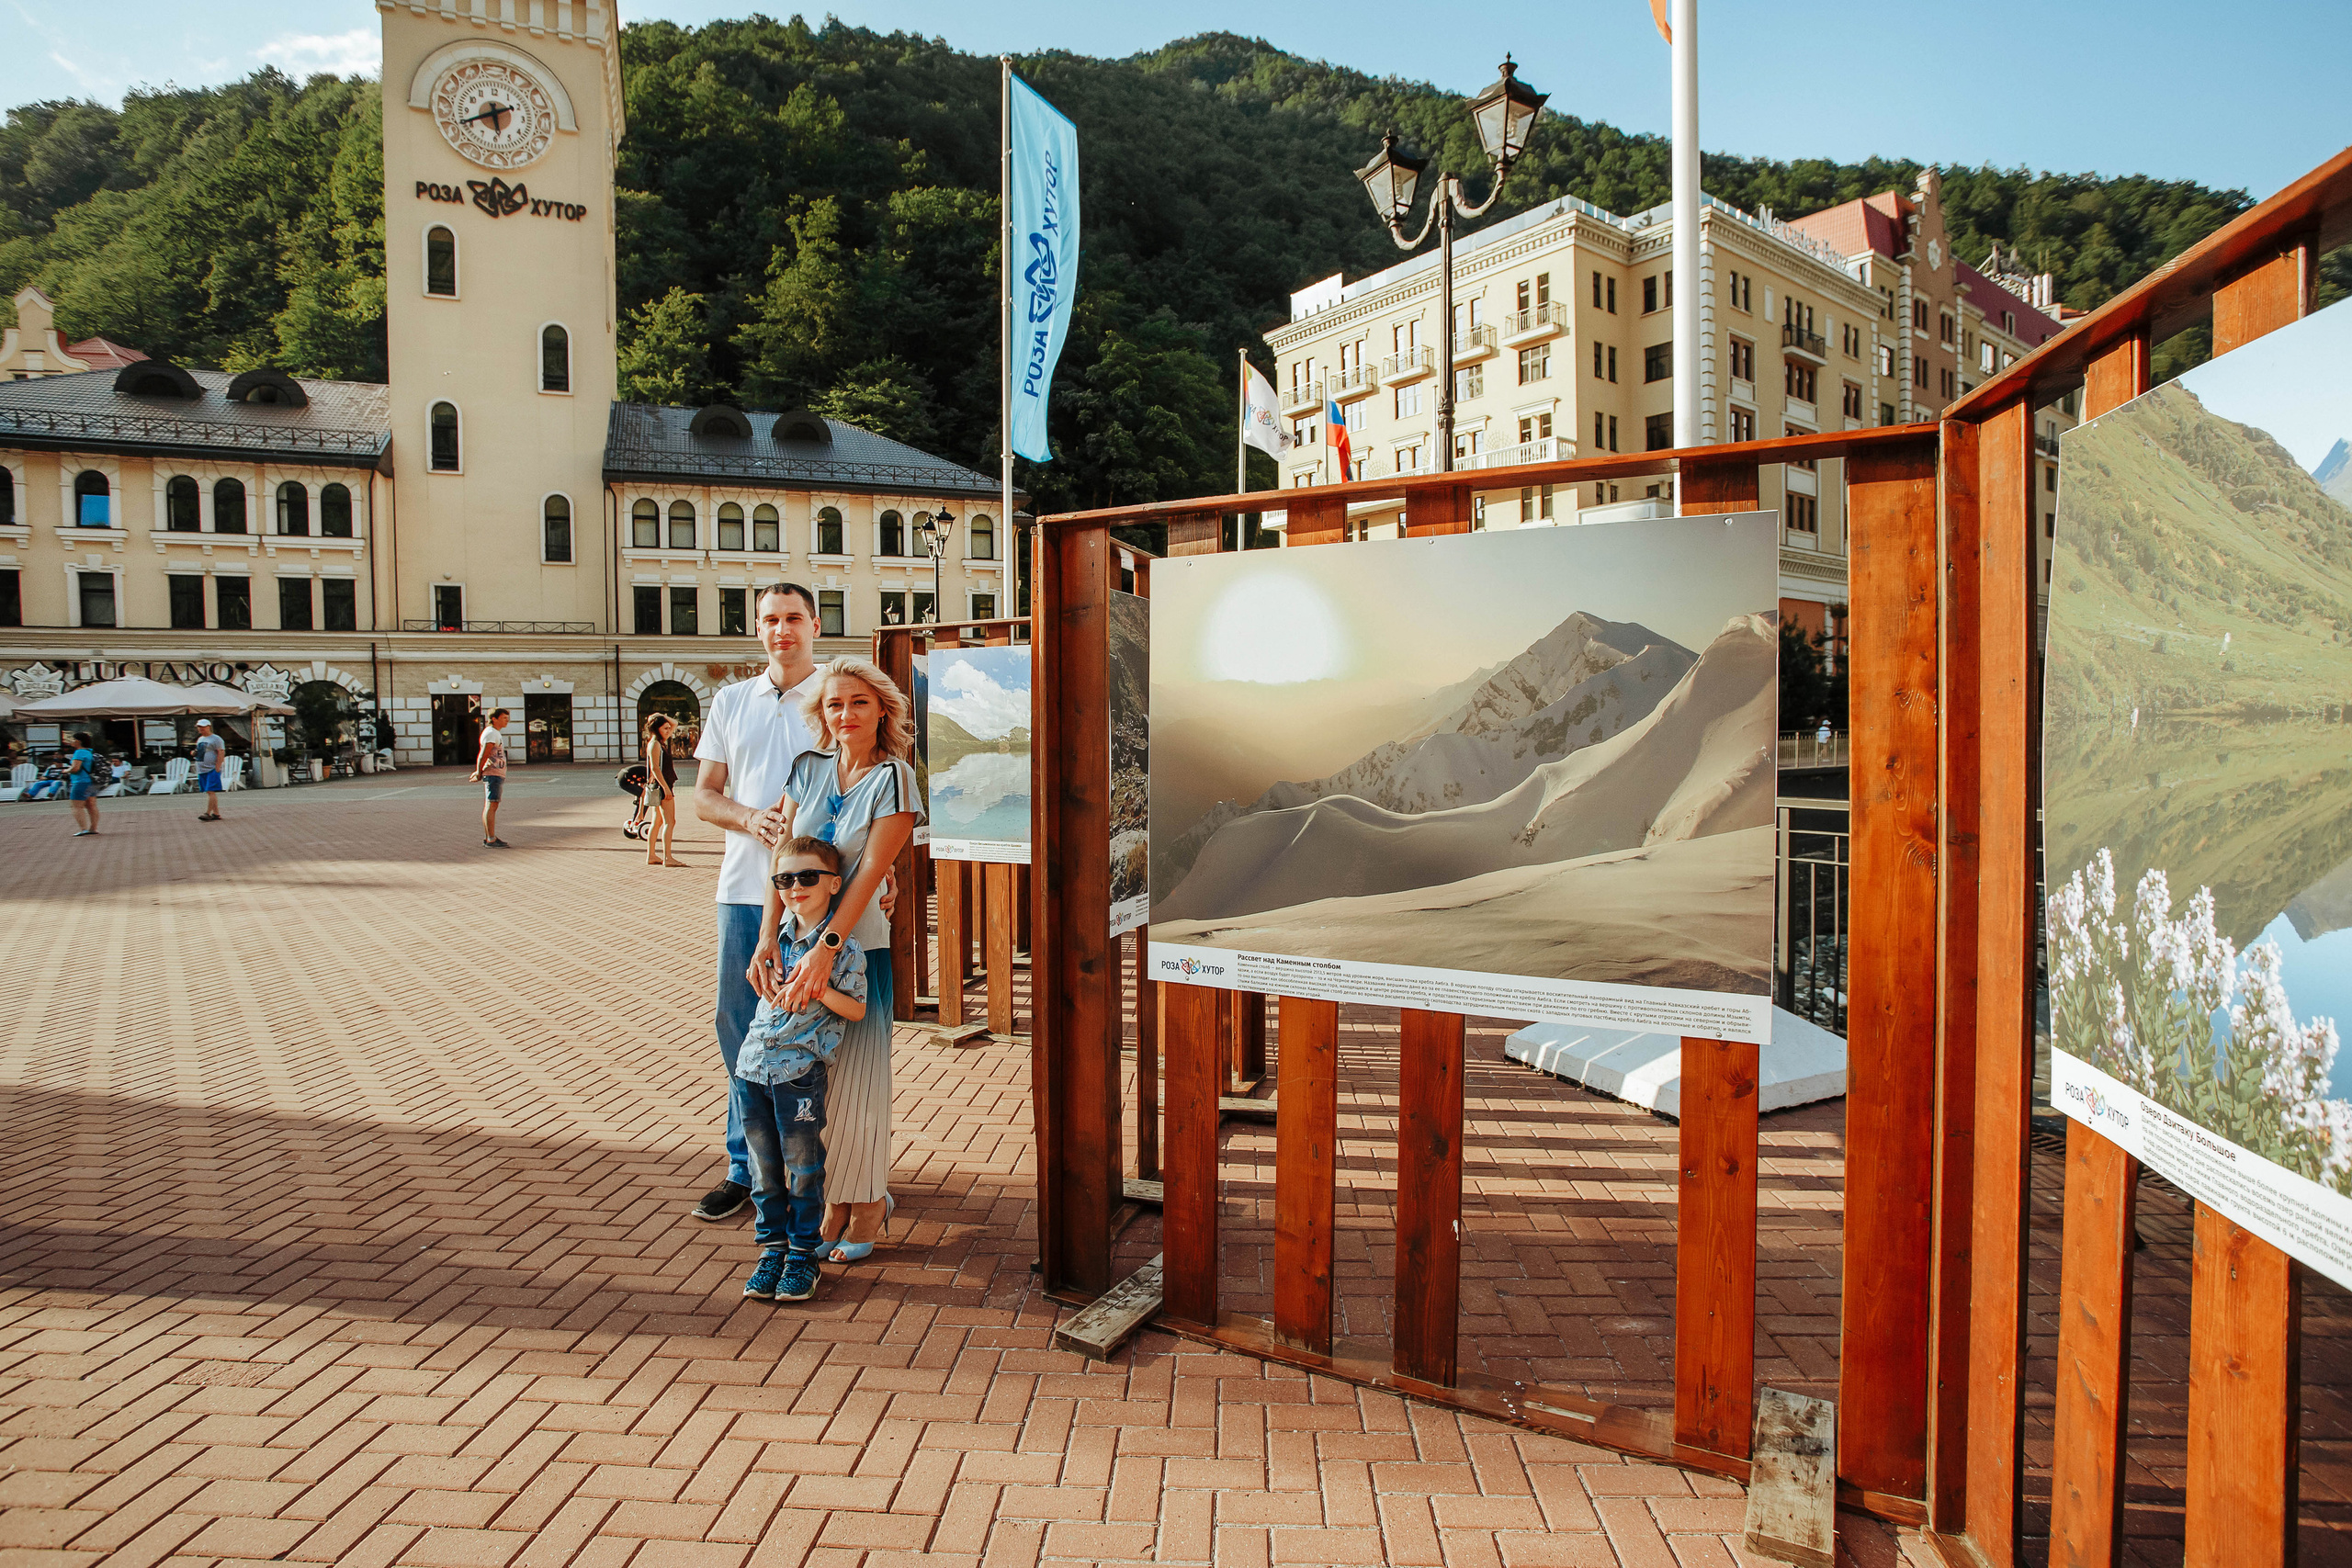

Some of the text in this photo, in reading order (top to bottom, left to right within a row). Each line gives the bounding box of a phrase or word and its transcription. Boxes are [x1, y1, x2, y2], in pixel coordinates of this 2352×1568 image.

[416, 181, 587, 221] РОЗА ХУТОР
[1024, 150, 1059, 398] РОЗА ХУТОР
[71, 661, 234, 682] LUCIANO
[734, 666, 762, 677] ROS
[1161, 960, 1225, 976] РОЗА ХУТОР
[1276, 957, 1311, 966] Каменным
[2065, 1082, 2129, 1130] РОЗА ХУТОР
[2140, 1100, 2235, 1162] Озеро Дзитаку Большое
[2251, 1188, 2274, 1206] восемь
[2295, 1211, 2321, 1231] разной
[2256, 1178, 2276, 1196] более
[2279, 1191, 2309, 1213] крупной
[2311, 1208, 2341, 1229] долины
[2252, 1211, 2279, 1232] высотой
[2297, 1235, 2343, 1267] расположен
[2301, 1226, 2328, 1247] хребта.
[2331, 1240, 2352, 1260] Озер
